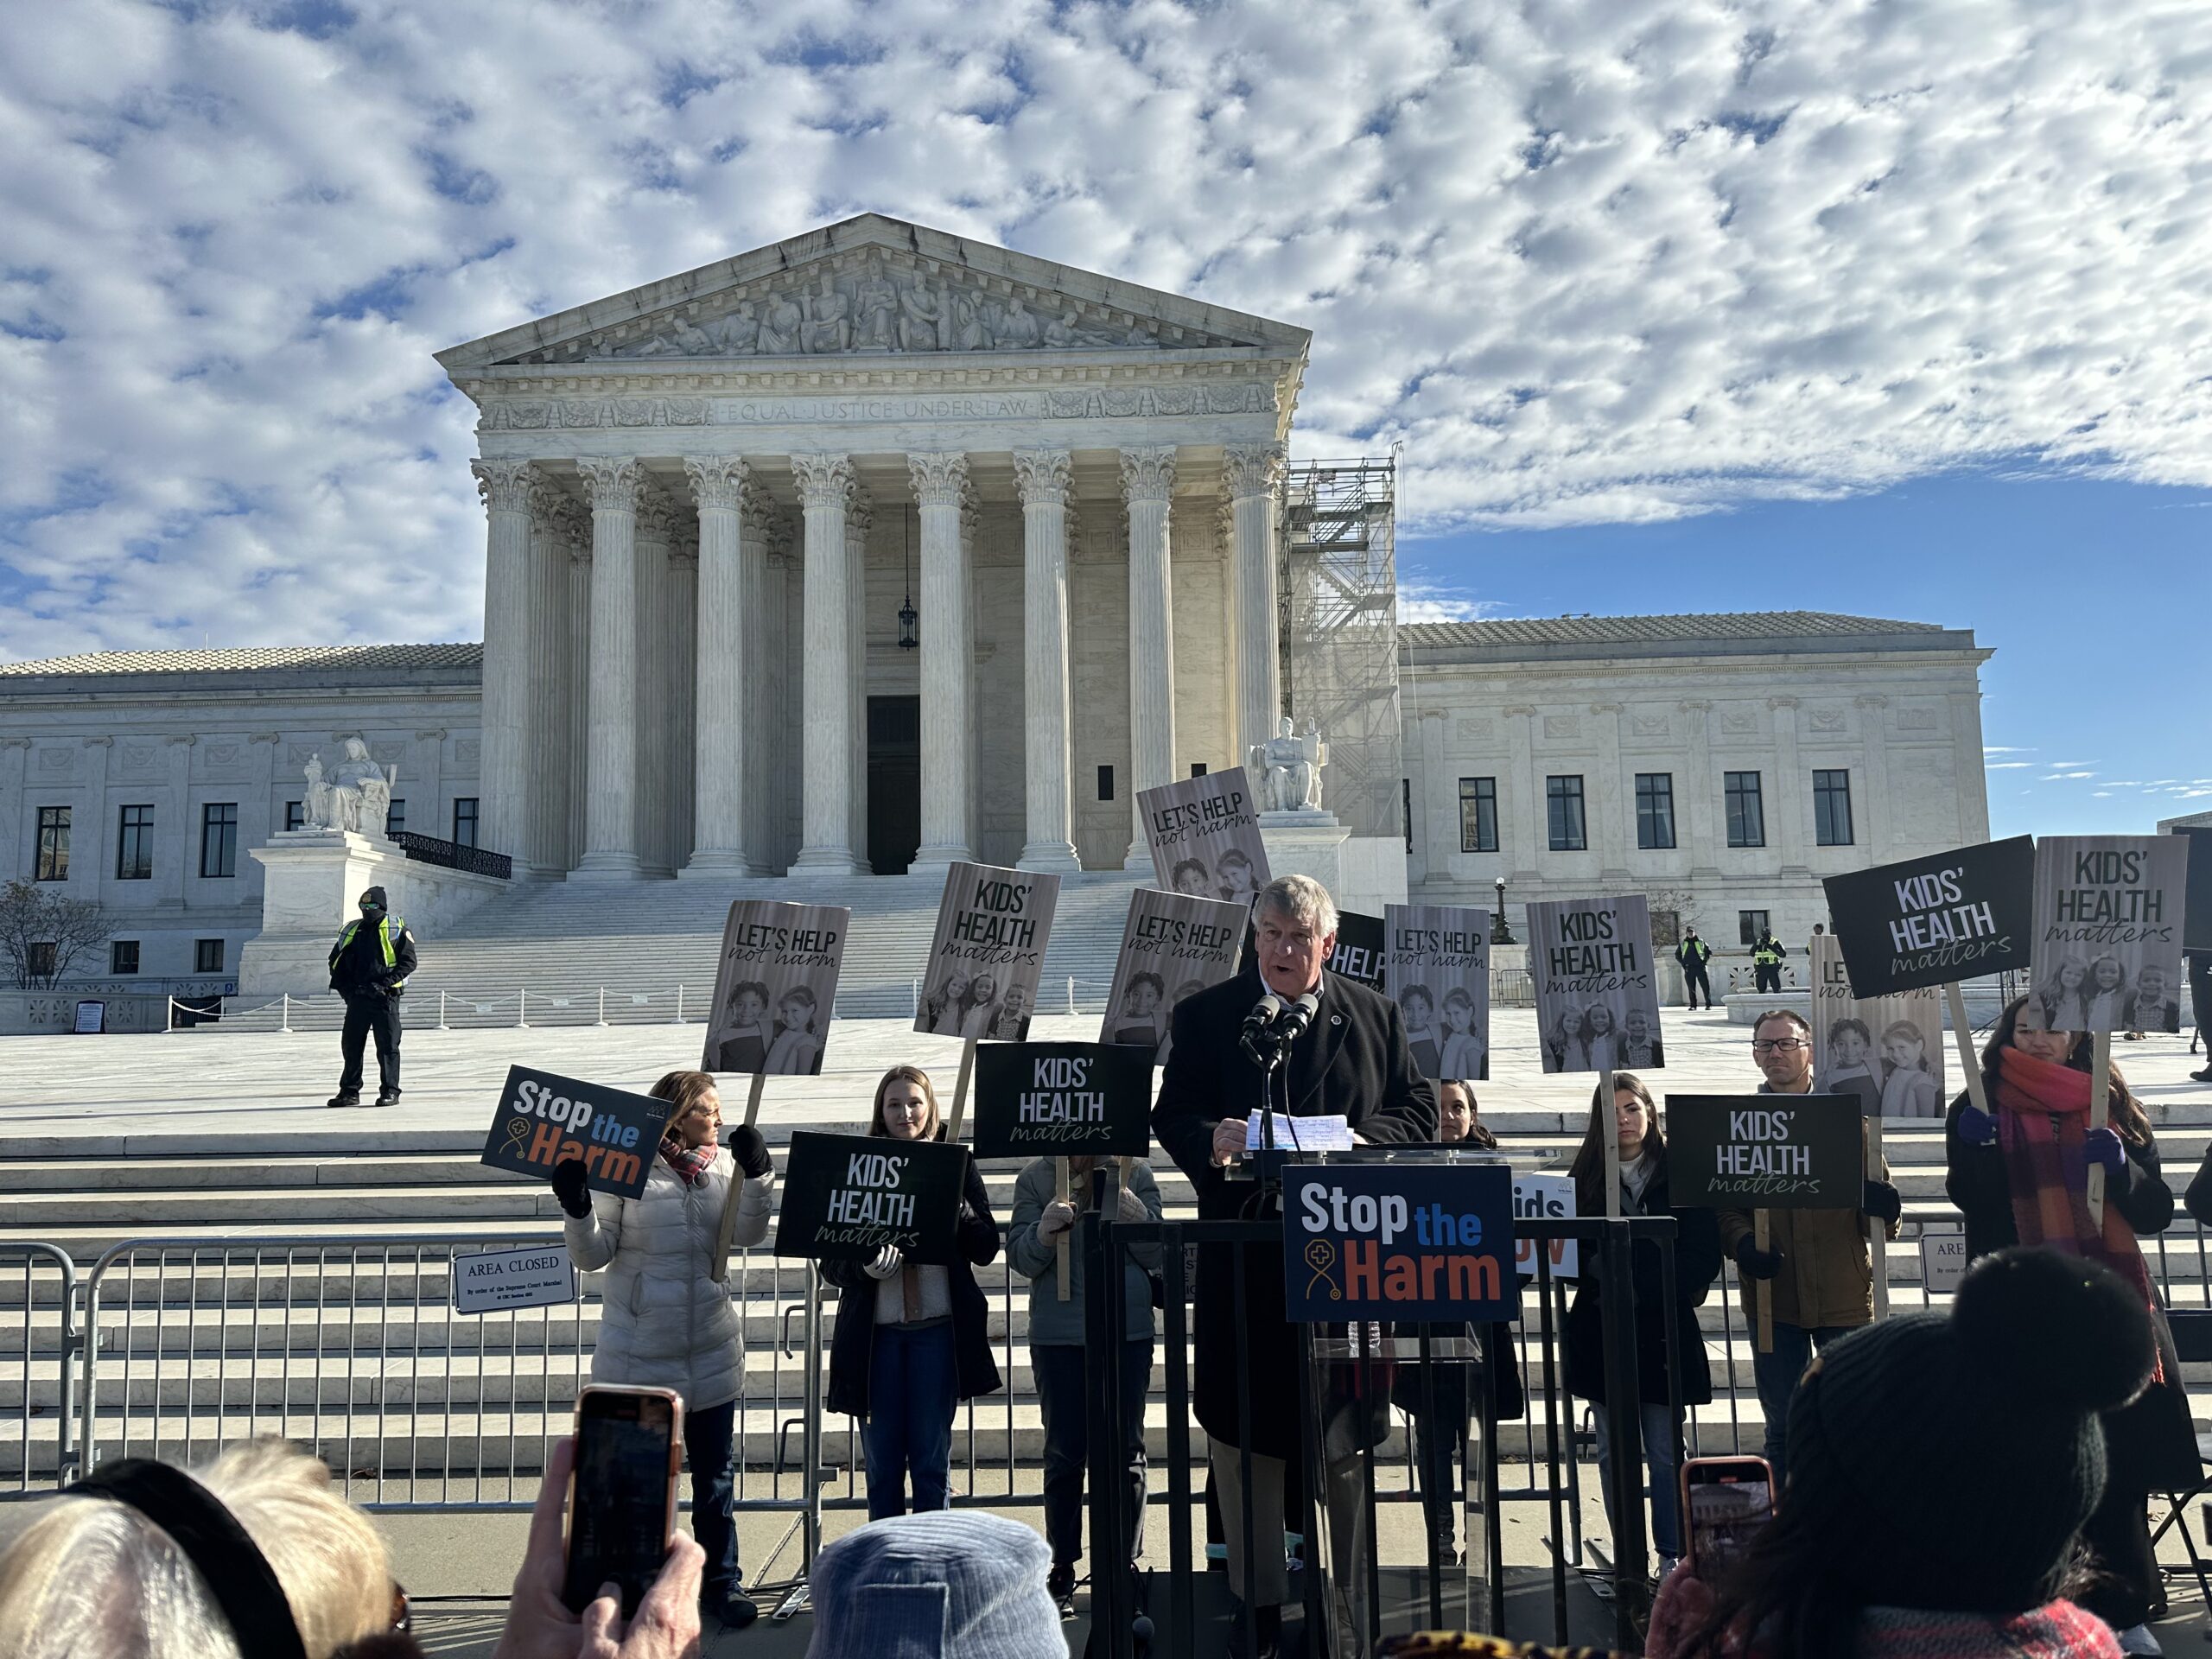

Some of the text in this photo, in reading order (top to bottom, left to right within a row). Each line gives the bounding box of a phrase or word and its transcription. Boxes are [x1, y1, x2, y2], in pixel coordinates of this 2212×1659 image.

[728, 398, 1027, 422] EQUAL JUSTICE UNDER LAW
[1153, 791, 1243, 833] LET'S HELP
[1154, 814, 1253, 847] not harm
[2075, 850, 2148, 885] KIDS'
[974, 879, 1033, 913] KIDS'
[1894, 867, 1964, 913] KIDS'
[2057, 889, 2163, 923] HEALTH
[736, 923, 836, 954] LET'S HELP
[954, 911, 1037, 949] HEALTH
[1136, 914, 1231, 950] LET'S HELP
[1395, 928, 1482, 955] LET'S HELP
[1560, 910, 1618, 942] KIDS'
[1889, 901, 1995, 953] HEALTH
[2044, 918, 2173, 944] matters
[728, 942, 837, 968] not harm
[940, 939, 1039, 967] matters
[1128, 933, 1230, 964] not harm
[1391, 944, 1485, 969] not harm
[1550, 944, 1636, 976] HEALTH
[1891, 934, 2012, 976] matters
[1545, 969, 1648, 995] matters
[1033, 1058, 1094, 1089] KIDS'
[513, 1080, 639, 1148] Stop the
[1020, 1091, 1104, 1122] HEALTH
[1009, 1117, 1113, 1141] matters
[1730, 1110, 1796, 1141] KIDS'
[527, 1122, 641, 1185] Harm
[1717, 1145, 1810, 1176] HEALTH
[847, 1154, 909, 1189] KIDS'
[1707, 1170, 1821, 1194] matters
[827, 1190, 916, 1227] HEALTH
[1300, 1182, 1482, 1246] Stop the
[1514, 1186, 1564, 1217] ids
[814, 1220, 920, 1248] matters
[1937, 1243, 1965, 1255] ARE
[467, 1256, 559, 1277] AREA CLOSED
[1344, 1239, 1501, 1301] Harm
